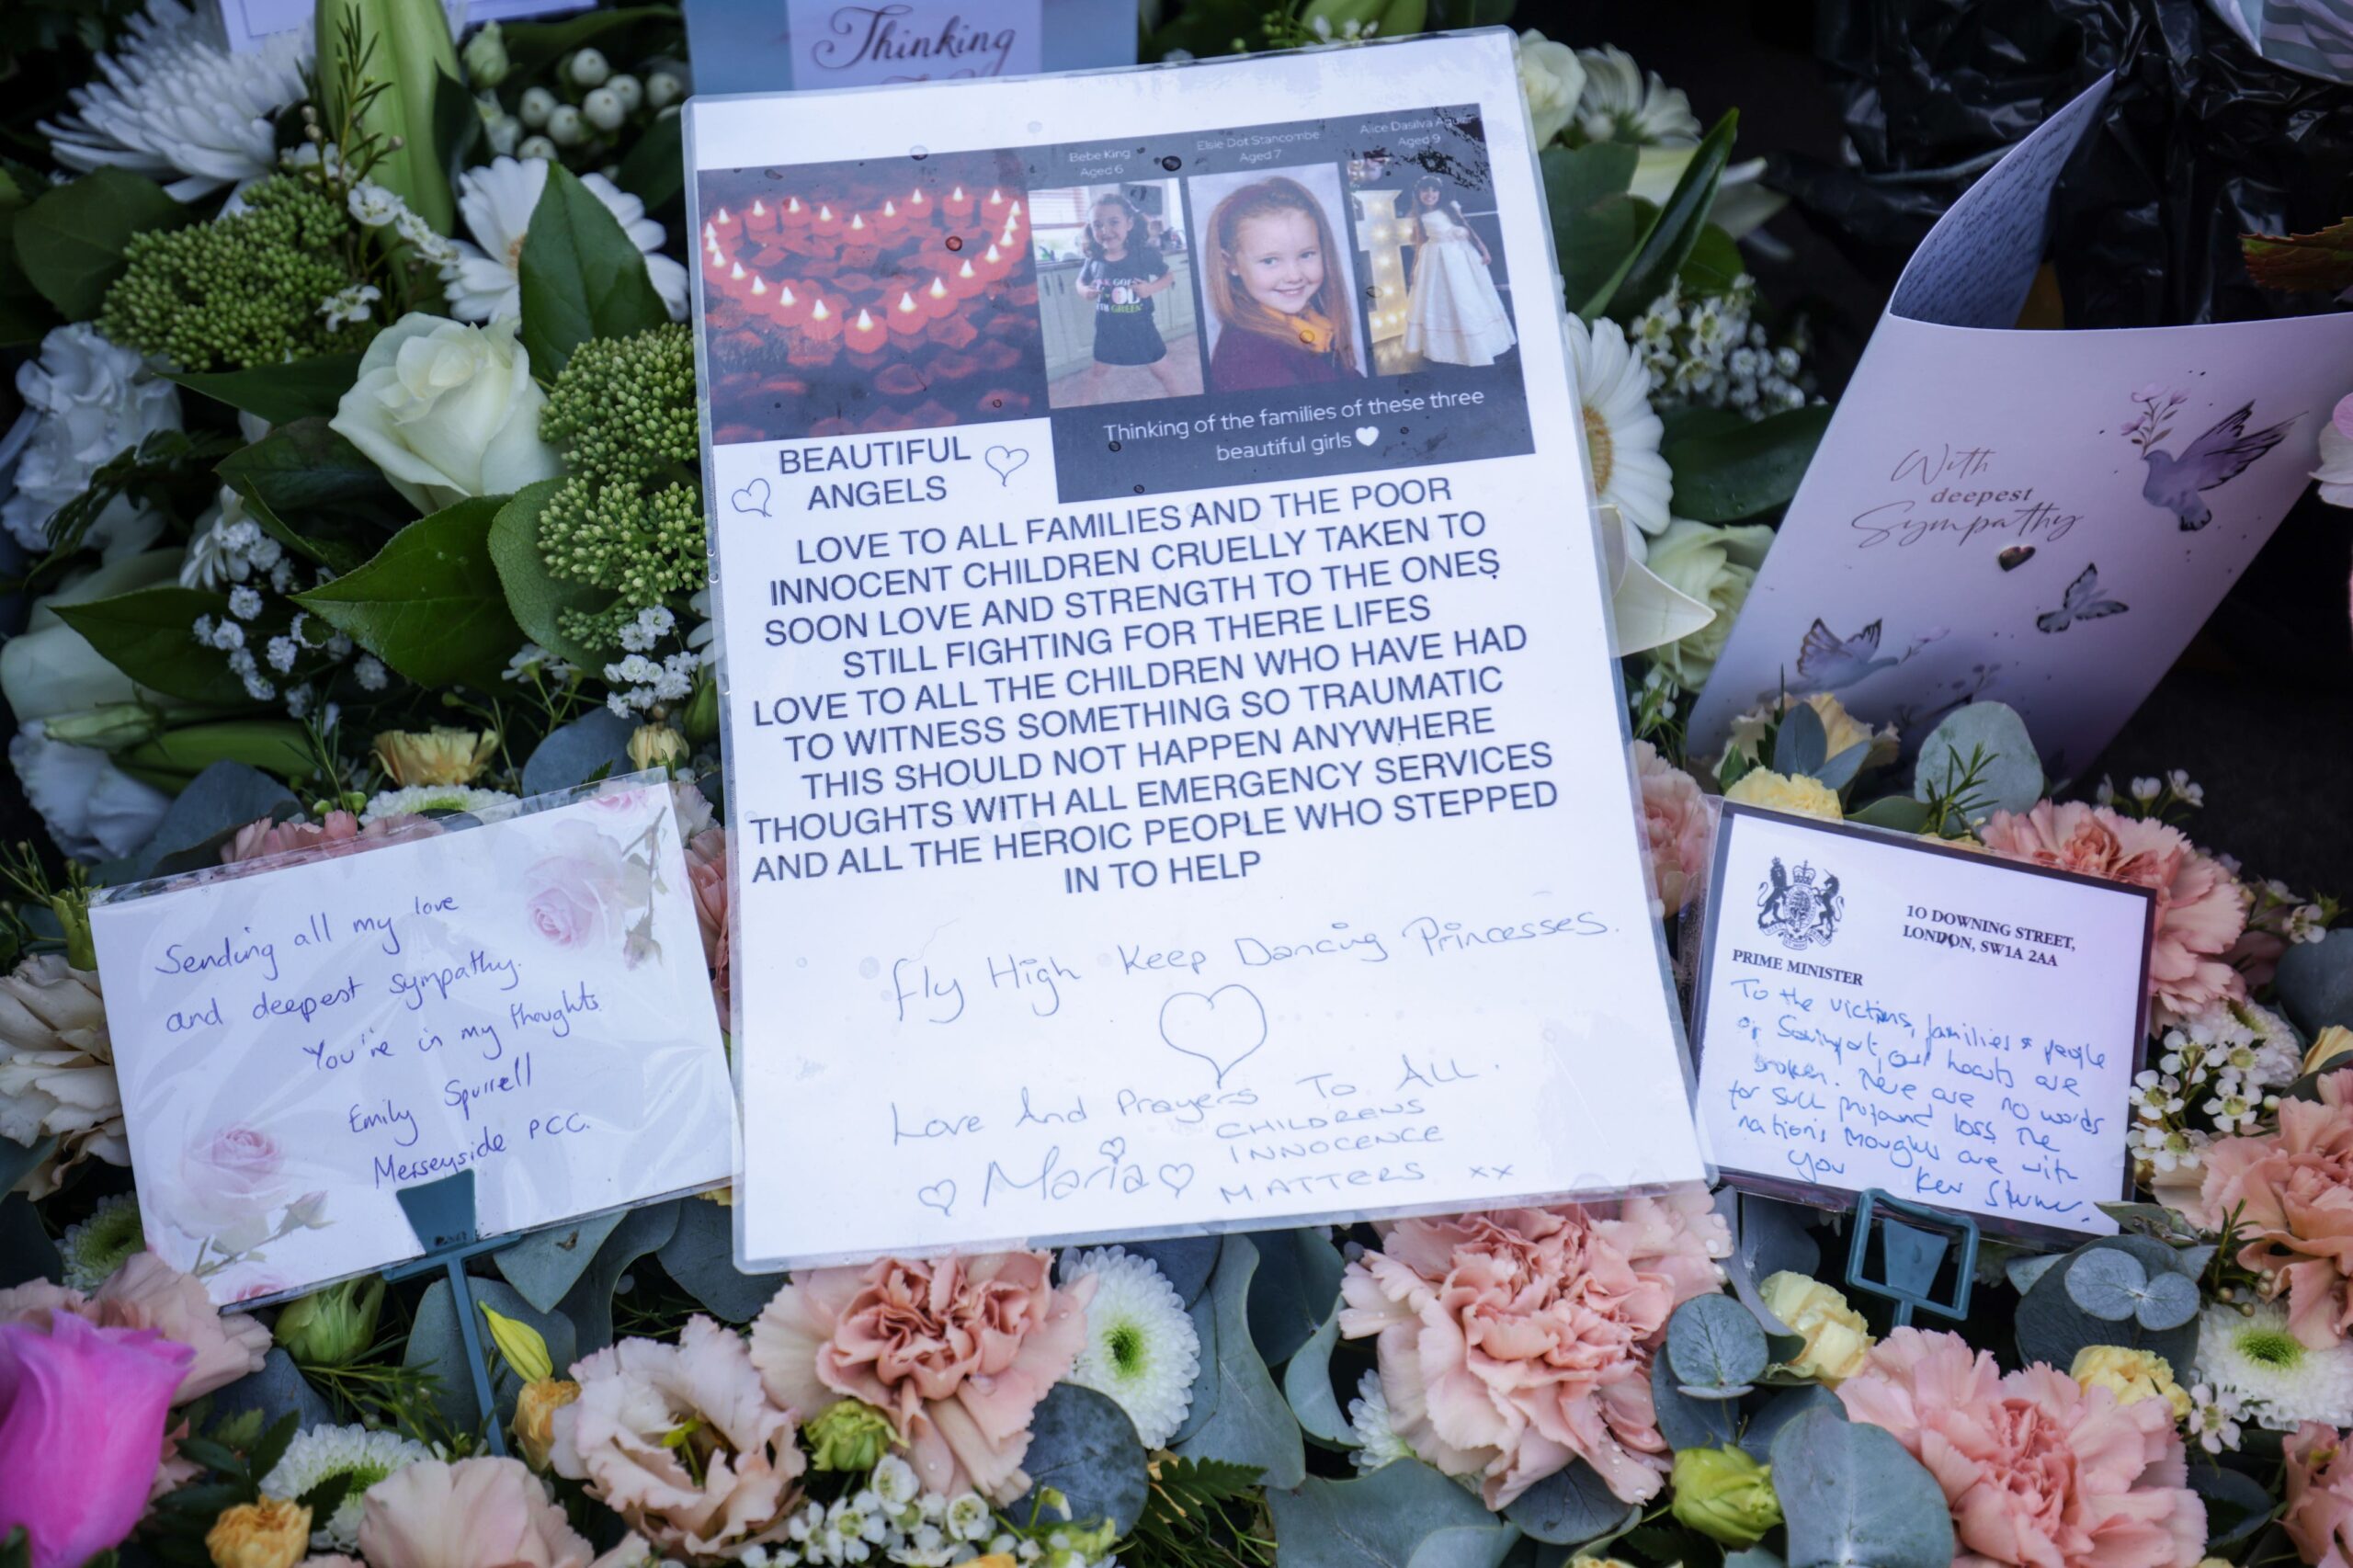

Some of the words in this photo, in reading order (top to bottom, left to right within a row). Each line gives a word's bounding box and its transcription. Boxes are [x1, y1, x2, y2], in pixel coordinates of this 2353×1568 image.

[812, 5, 1016, 76] Thinking
[1197, 139, 1224, 151] Elsie
[1227, 137, 1250, 148] Dot
[1251, 131, 1320, 146] Stancombe
[1360, 123, 1389, 135] Alice
[1398, 135, 1429, 148] Aged
[1432, 133, 1441, 144] 9
[1069, 152, 1100, 163] Bebe
[1104, 148, 1131, 161] King
[1080, 167, 1112, 179] Aged
[1115, 166, 1124, 175] 6
[1240, 151, 1271, 165] Aged
[1273, 149, 1282, 159] 7
[1104, 418, 1189, 441] Thinking
[1195, 415, 1218, 433] of
[1221, 410, 1256, 431] the
[1259, 404, 1337, 427] families
[1342, 398, 1365, 418] of
[1369, 395, 1425, 415] these
[1429, 390, 1485, 410] three
[779, 436, 972, 474] BEAUTIFUL
[1217, 435, 1306, 460] beautiful
[1312, 431, 1352, 455] girls
[1891, 443, 1996, 485] With
[808, 476, 948, 510] ANGELS
[1930, 487, 2034, 507] deepest
[797, 532, 890, 564] LOVE
[899, 528, 947, 555] TO
[956, 522, 1017, 551] ALL
[1027, 506, 1181, 544] FAMILIES
[1190, 497, 1261, 528] AND
[1270, 488, 1341, 518] THE
[1351, 477, 1452, 510] POOR
[1852, 501, 2085, 549] Sympathy
[770, 565, 952, 607] INNOCENT
[963, 547, 1140, 589] CHILDREN
[1152, 528, 1306, 570] CRUELLY
[1316, 517, 1429, 552] TAKEN
[1438, 510, 1486, 540] TO
[765, 612, 868, 646] SOON
[881, 603, 972, 636] LOVE
[983, 596, 1053, 627] AND
[1065, 575, 1256, 619] STRENGTH
[1265, 568, 1313, 598] TO
[1321, 560, 1392, 591] THE
[1402, 548, 1500, 583] ONES
[844, 644, 938, 678] STILL
[947, 628, 1112, 669] FIGHTING
[1124, 619, 1196, 651] FOR
[1205, 606, 1324, 642] THERE
[1334, 595, 1430, 630] LIFES
[754, 693, 847, 726] LOVE
[858, 687, 905, 716] TO
[915, 681, 978, 711] ALL
[984, 672, 1056, 704] THE
[1065, 653, 1245, 697] CHILDREN
[1255, 644, 1339, 677] WHO
[1351, 632, 1443, 667] HAVE
[1454, 624, 1528, 657] HAD
[785, 732, 834, 762] TO
[845, 716, 1006, 756] WITNESS
[1018, 694, 1230, 740] SOMETHING
[1242, 688, 1290, 719] SO
[1300, 665, 1504, 711] TRAUMATIC
[801, 767, 883, 800] THIS
[895, 752, 1042, 791] SHOULD
[1054, 744, 1127, 776] NOT
[1138, 728, 1281, 768] HAPPEN
[1292, 706, 1495, 752] ANYWHERE
[749, 801, 953, 844] THOUGHTS
[963, 790, 1055, 824] WITH
[1065, 784, 1128, 815] ALL
[1138, 759, 1364, 807] EMERGENCY
[1375, 741, 1553, 784] SERVICES
[752, 852, 828, 882] AND
[837, 845, 904, 875] ALL
[910, 836, 983, 868] THE
[994, 822, 1132, 861] HEROIC
[1145, 808, 1286, 846] PEOPLE
[1295, 798, 1382, 830] WHO
[1394, 780, 1559, 822] STEPPED
[1064, 865, 1099, 894] IN
[1108, 860, 1158, 890] TO
[1170, 850, 1261, 884] HELP
[154, 926, 278, 981] Sending
[294, 912, 332, 946] all
[353, 917, 401, 955] my
[415, 896, 459, 915] love
[1903, 925, 1976, 953] LONDON,
[1980, 939, 2024, 960] SW1A
[2029, 949, 2059, 968] 2AA
[1907, 903, 1927, 921] 10
[1931, 908, 2012, 937] DOWNING
[2015, 926, 2077, 952] STREET,
[988, 954, 1081, 1017] High
[1234, 921, 1388, 966] Dancing
[1732, 948, 1783, 971] PRIME
[1787, 960, 1864, 987] MINISTER
[166, 997, 223, 1032] and
[252, 976, 364, 1023] deepest
[1731, 978, 1769, 1001] To
[1779, 987, 1813, 1012] the
[2045, 1040, 2105, 1070] people
[418, 1028, 443, 1052] in
[461, 1025, 502, 1060] my
[349, 1099, 418, 1147] Emily
[892, 1102, 985, 1145] Love
[1016, 1086, 1087, 1128] And
[1118, 1088, 1258, 1124] Prayers
[1216, 1099, 1426, 1139] CHILDRENS
[374, 1126, 506, 1188] Merseyside
[1230, 1126, 1444, 1164] INNOCENCE
[983, 1145, 1149, 1208] Maria
[1220, 1163, 1425, 1204] MATTERS
